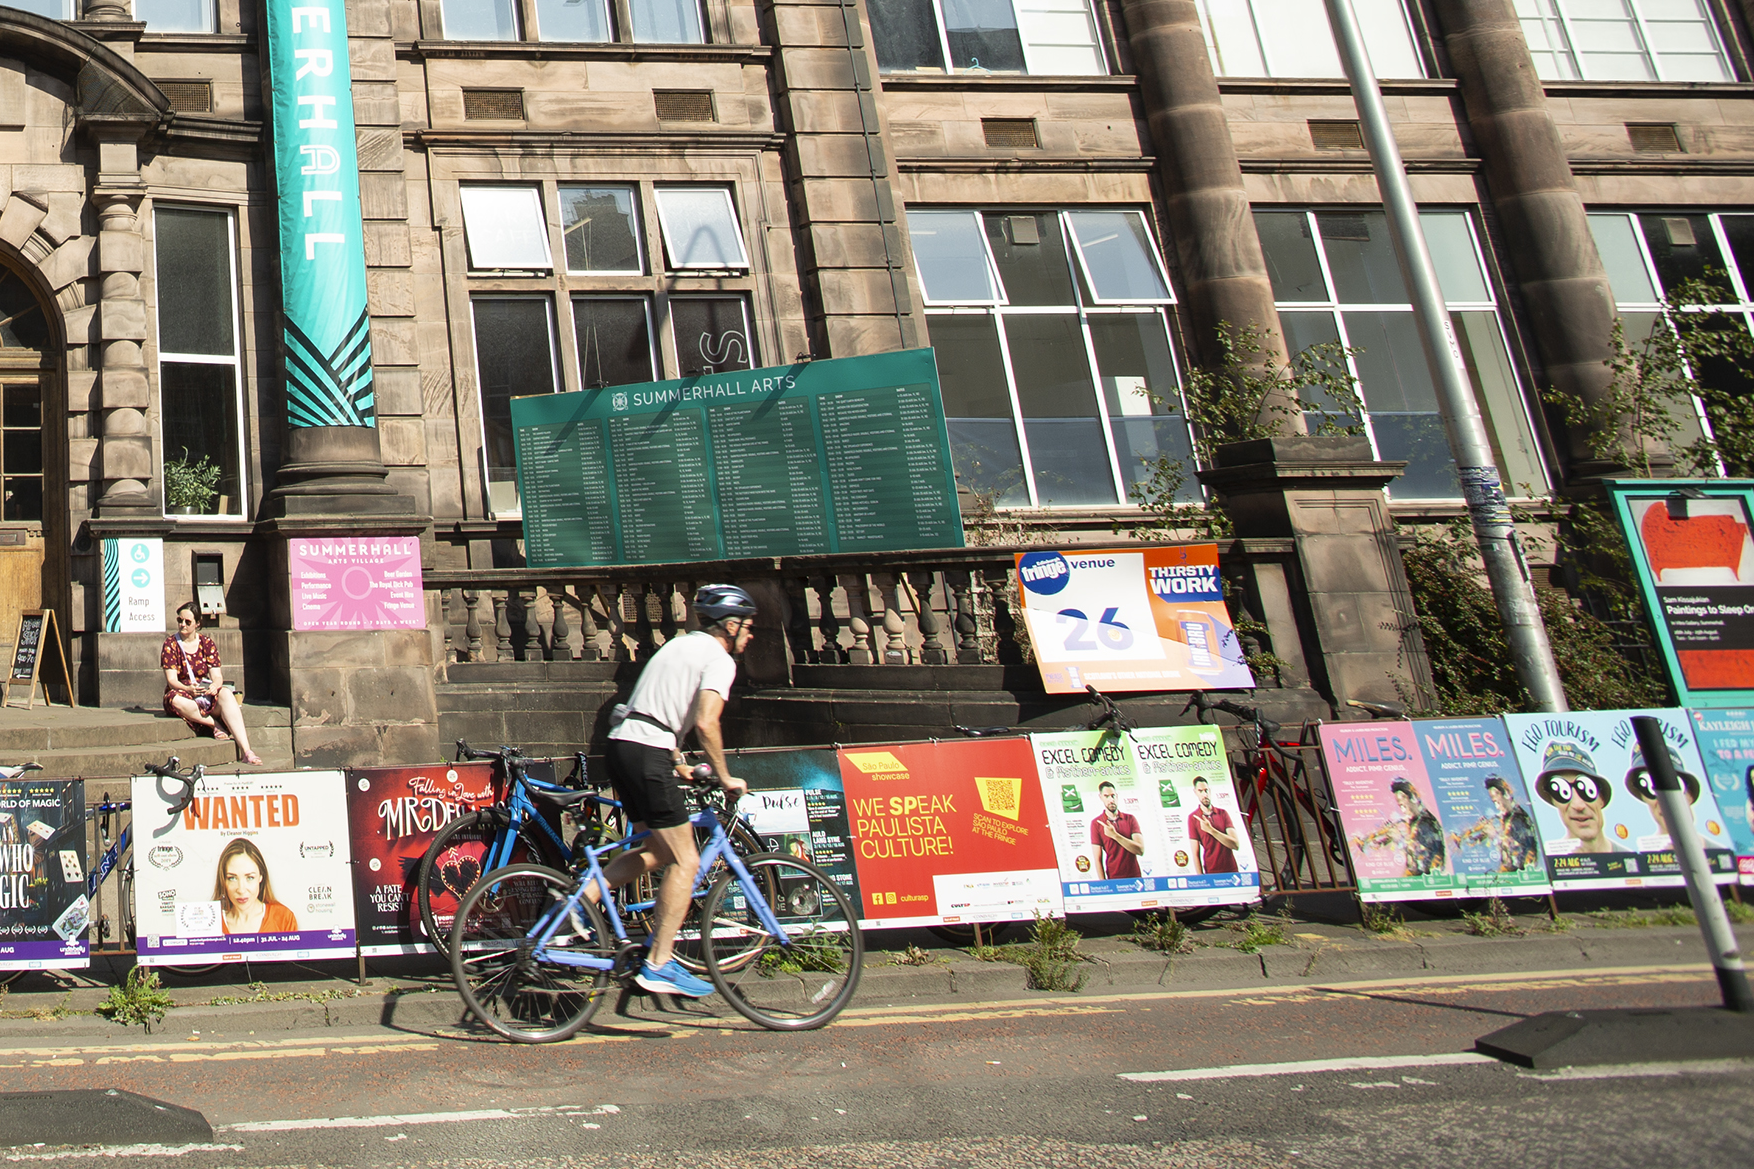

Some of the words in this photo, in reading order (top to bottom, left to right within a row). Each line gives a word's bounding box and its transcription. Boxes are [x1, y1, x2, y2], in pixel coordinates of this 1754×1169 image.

[633, 381, 745, 407] SUMMERHALL
[751, 375, 796, 393] ARTS
[300, 544, 411, 556] SUMMERHALL
[1021, 560, 1066, 582] fringe
[1070, 558, 1116, 570] venue
[1148, 565, 1216, 578] THIRSTY
[379, 581, 392, 589] Royal
[1149, 577, 1218, 595] WORK
[128, 597, 149, 607] Ramp
[129, 612, 155, 621] Access
[1666, 605, 1708, 616] Paintings
[1707, 606, 1718, 614] to
[1718, 605, 1744, 616] Sleep
[1056, 607, 1134, 651] 26
[1698, 721, 1751, 731] KAYLEIGH
[1522, 723, 1543, 753] EGO
[1543, 720, 1600, 752] TOURISM
[1332, 736, 1413, 763] MILES.
[1425, 732, 1505, 760] MILES.
[1720, 739, 1738, 748] FED
[1042, 749, 1079, 765] EXCEL
[1081, 746, 1126, 763] COMEDY
[1137, 743, 1174, 760] EXCEL
[1175, 741, 1218, 758] COMEDY
[1717, 750, 1732, 759] TO
[1734, 750, 1742, 759] A
[862, 762, 877, 770] São
[878, 761, 899, 770] Paulo
[872, 772, 910, 781] showcase
[409, 777, 446, 798] Falling
[448, 788, 457, 797] in
[454, 783, 475, 802] Love
[477, 783, 494, 798] with
[18, 800, 31, 808] OF
[32, 799, 61, 808] MAGIC
[853, 798, 885, 817] WE
[889, 794, 957, 816] SPEAK
[181, 794, 299, 830] WANTED
[857, 816, 946, 838] PAULISTA
[973, 813, 990, 824] SCAN
[991, 818, 1001, 827] TO
[1000, 820, 1028, 836] EXPLORE
[986, 823, 1008, 836] PAULO
[538, 817, 565, 849] PINNACLE
[981, 829, 994, 839] THE
[994, 833, 1016, 845] FRINGE
[157, 845, 173, 853] fringe
[860, 836, 954, 859] CULTURE!
[1554, 859, 1567, 867] 2-24
[1568, 858, 1579, 867] AUG
[1660, 853, 1673, 862] AUG
[375, 886, 381, 894] A
[383, 884, 402, 893] FATE
[370, 893, 387, 903] YOU
[388, 892, 410, 903] CAN'T
[901, 894, 929, 902] culturasp
[377, 903, 403, 912] RESIST
